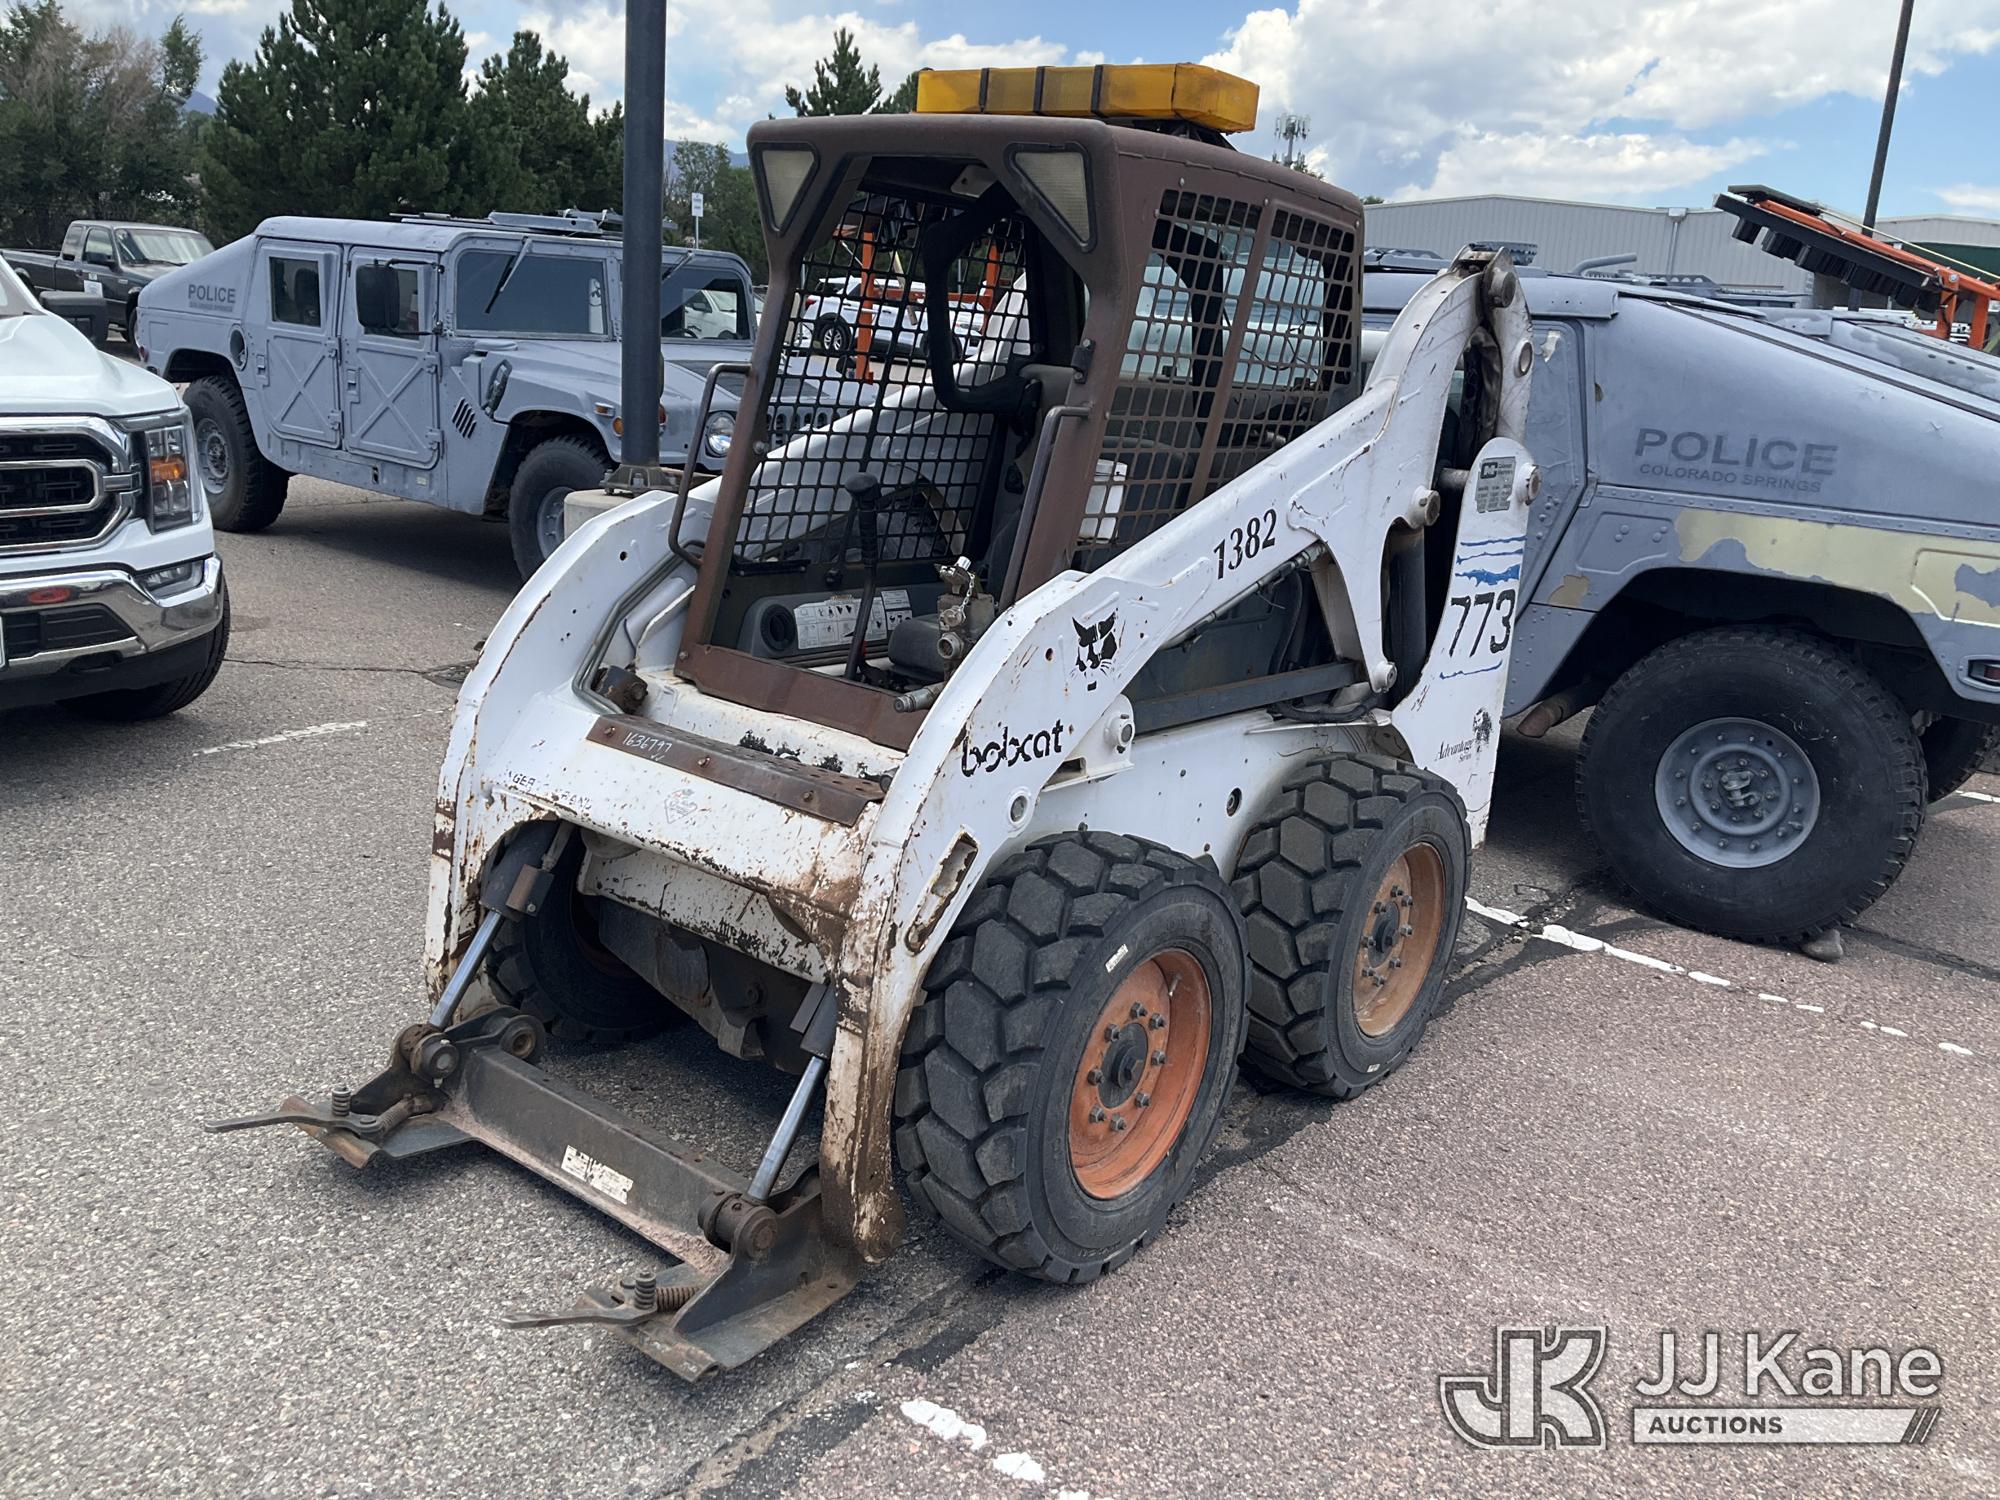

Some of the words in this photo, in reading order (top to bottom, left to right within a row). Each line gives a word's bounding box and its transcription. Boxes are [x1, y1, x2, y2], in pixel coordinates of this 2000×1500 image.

[188, 284, 236, 304] POLICE
[1634, 428, 1839, 476] POLICE
[1639, 463, 1737, 484] COLORADO
[1741, 474, 1822, 493] SPRINGS
[1213, 508, 1277, 580] 1382
[1449, 589, 1516, 658] 773
[961, 719, 1064, 777] bobcat
